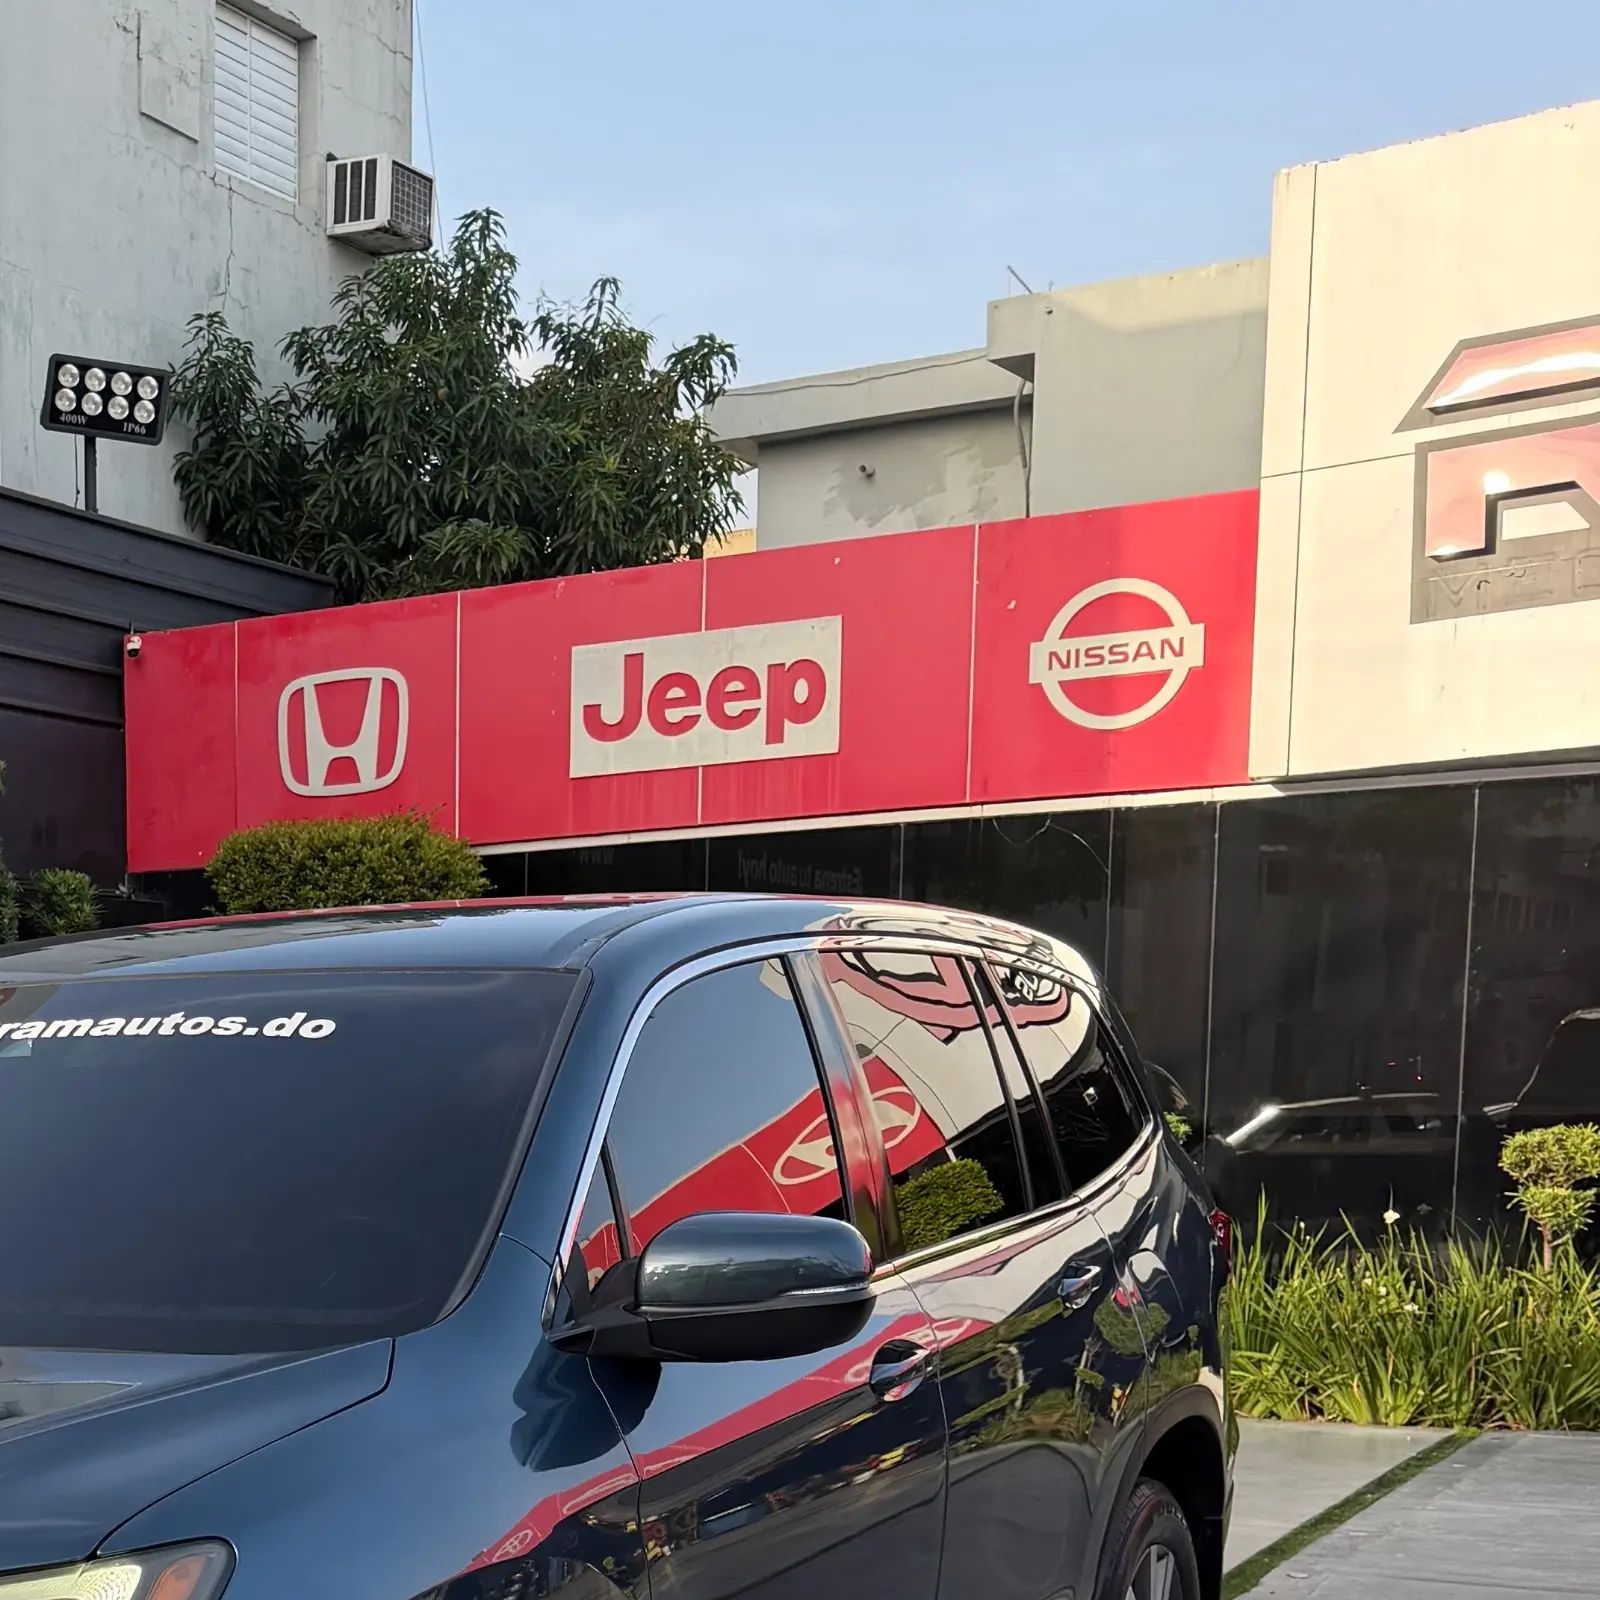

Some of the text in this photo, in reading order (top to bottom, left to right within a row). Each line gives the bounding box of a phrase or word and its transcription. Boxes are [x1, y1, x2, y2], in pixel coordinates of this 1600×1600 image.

[60, 412, 88, 426] 400W
[123, 421, 147, 435] IP66
[1048, 636, 1185, 671] NISSAN
[582, 652, 827, 746] Jeep
